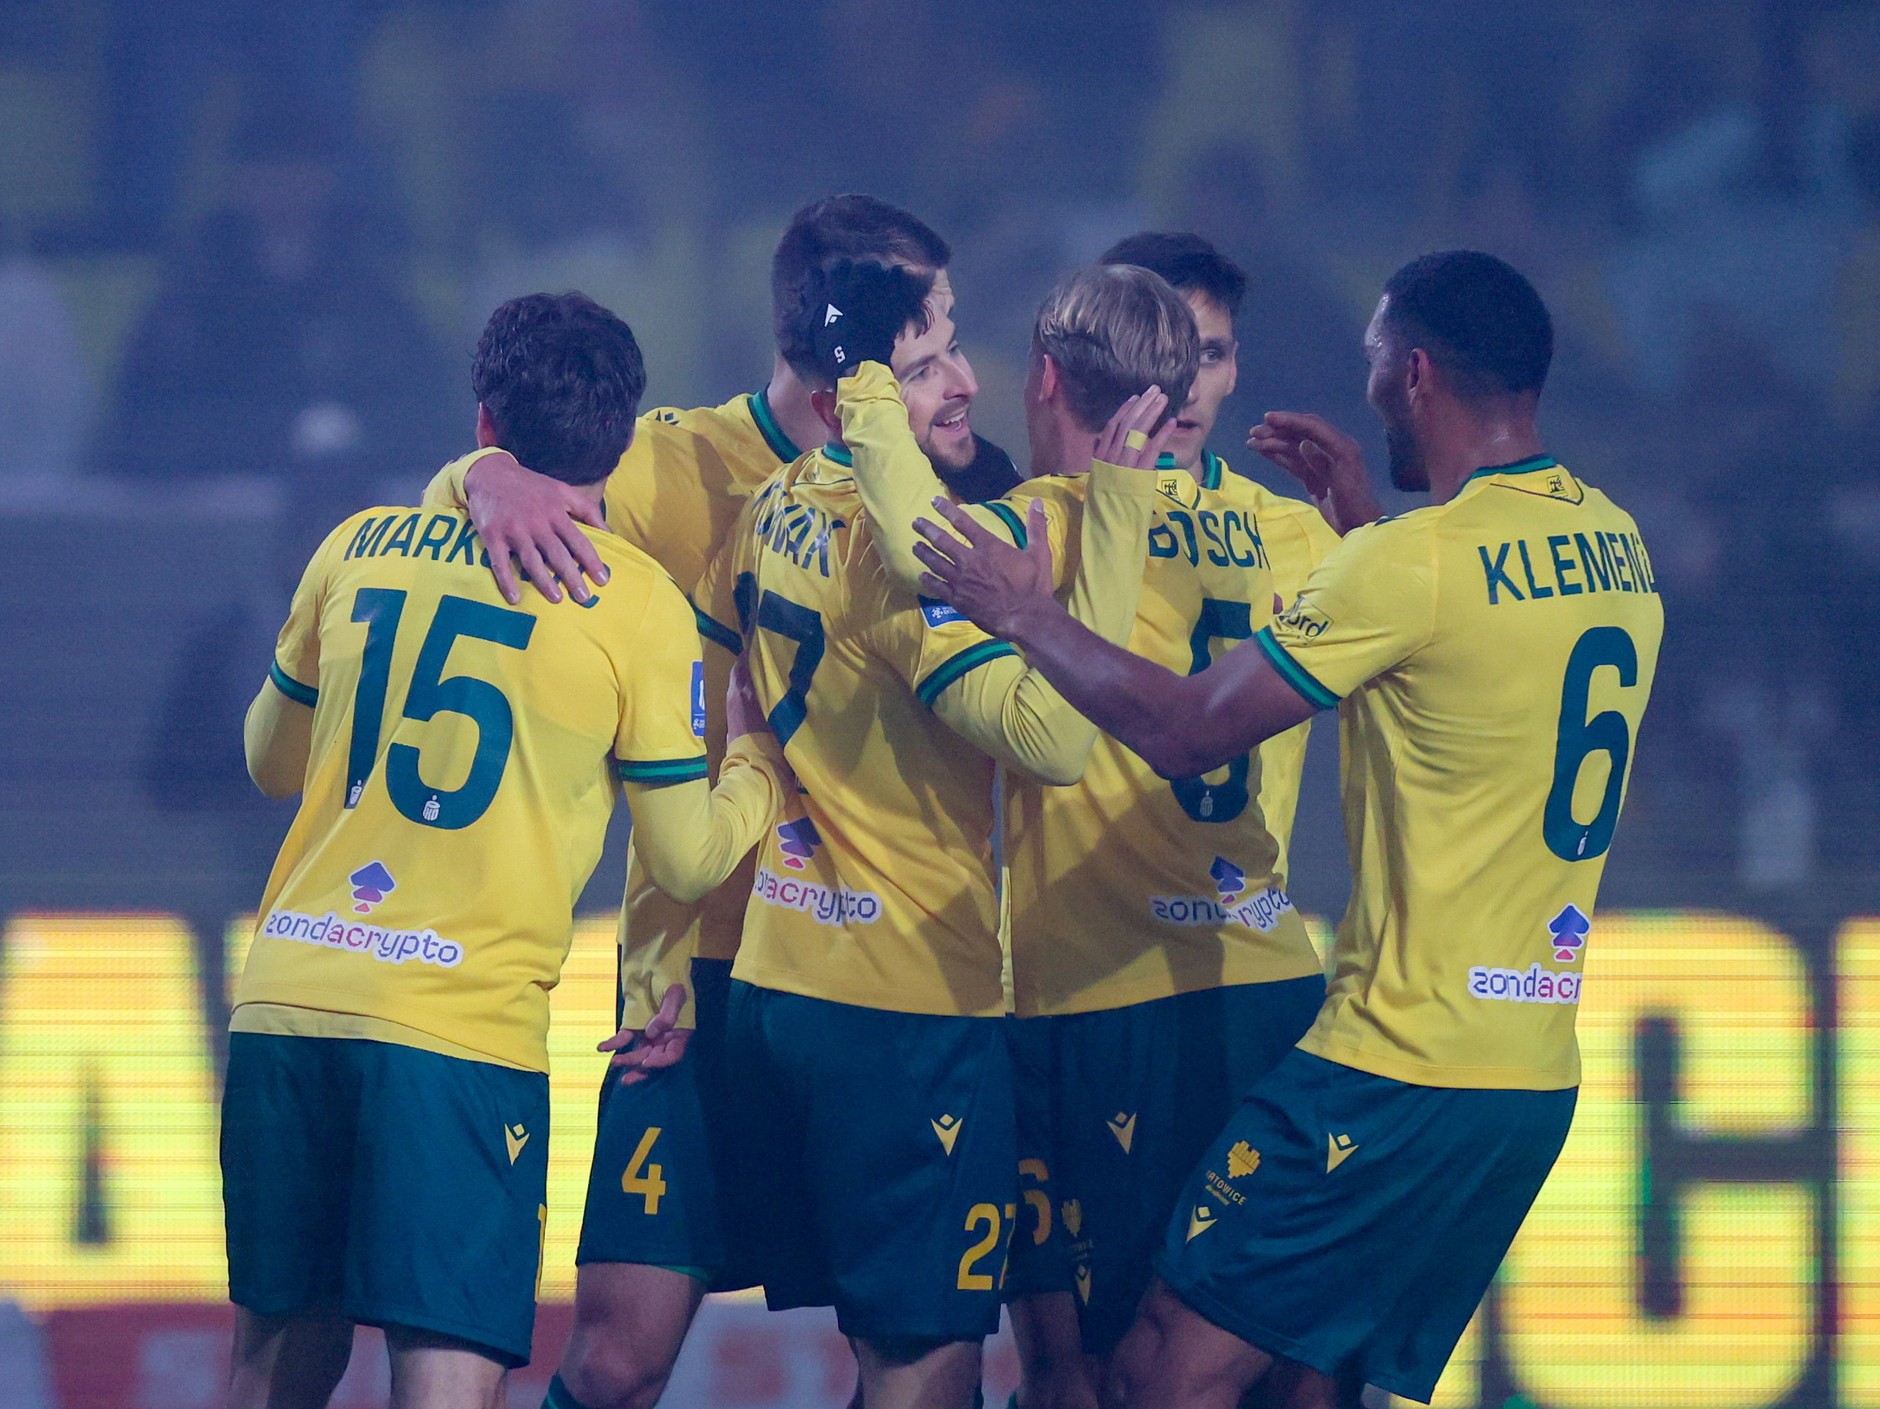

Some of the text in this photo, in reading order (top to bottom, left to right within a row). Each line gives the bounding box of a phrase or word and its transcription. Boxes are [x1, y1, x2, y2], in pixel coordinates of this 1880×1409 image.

[343, 587, 537, 830] 15
[1543, 626, 1638, 862] 6
[265, 913, 459, 963] zondacrypto
[1472, 967, 1582, 999] zondacr
[622, 1126, 666, 1215] 4
[1205, 1170, 1247, 1206] ATOWICE
